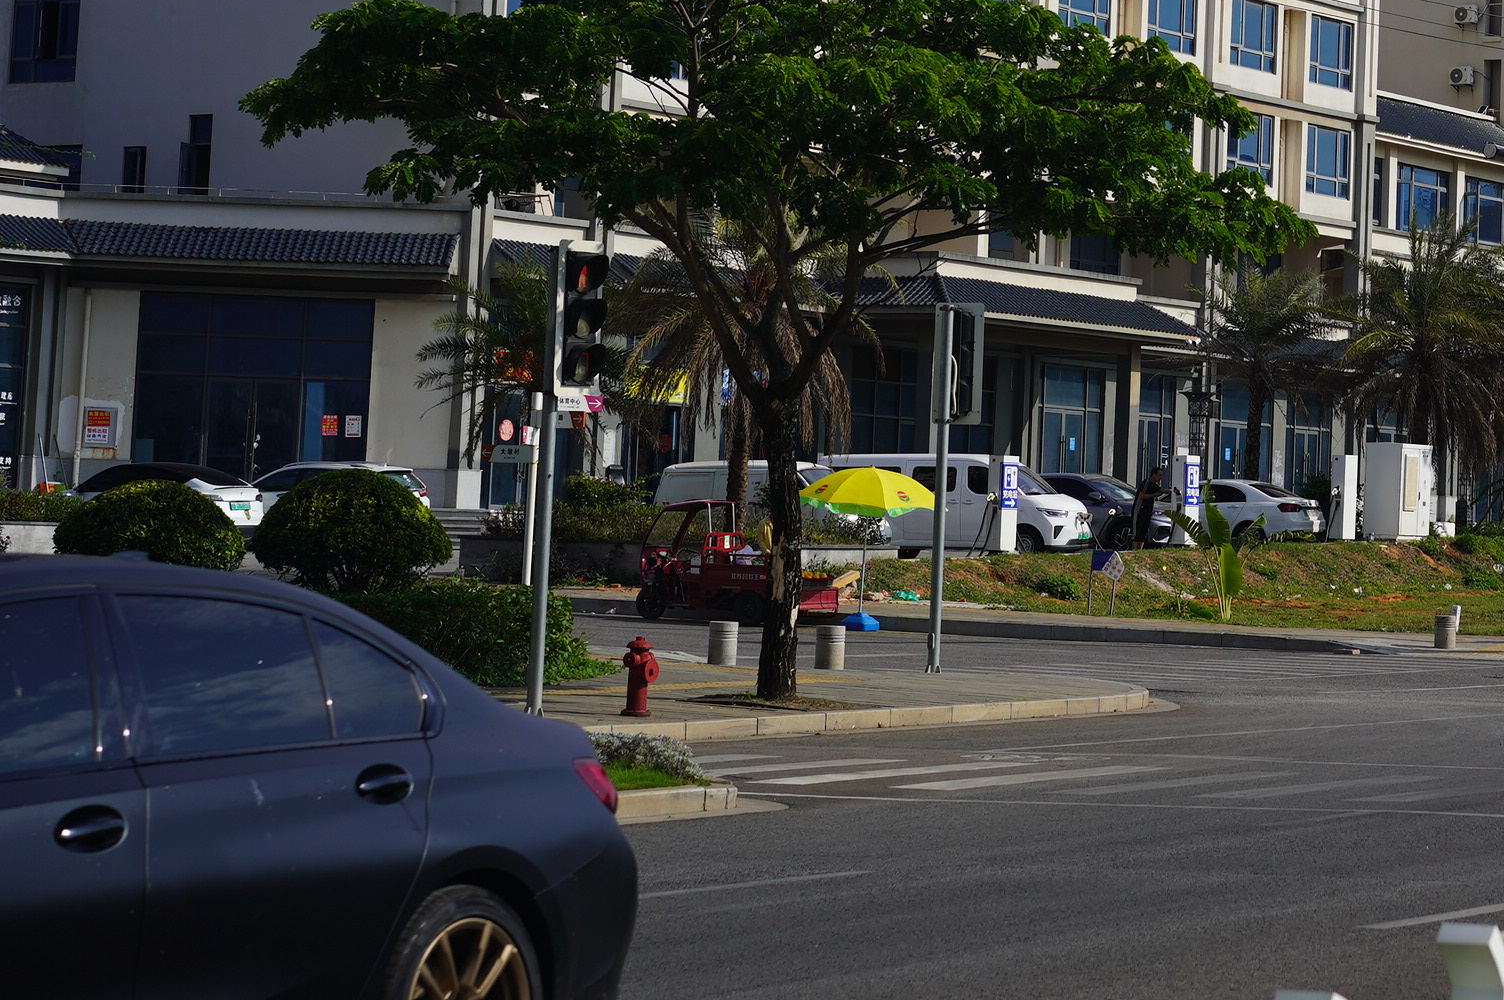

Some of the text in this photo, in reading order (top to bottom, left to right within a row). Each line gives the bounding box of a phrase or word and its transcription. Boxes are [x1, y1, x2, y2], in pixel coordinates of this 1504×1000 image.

[0, 294, 22, 307] 融合
[555, 397, 581, 405] 体育中心
[1002, 490, 1018, 499] 充电站
